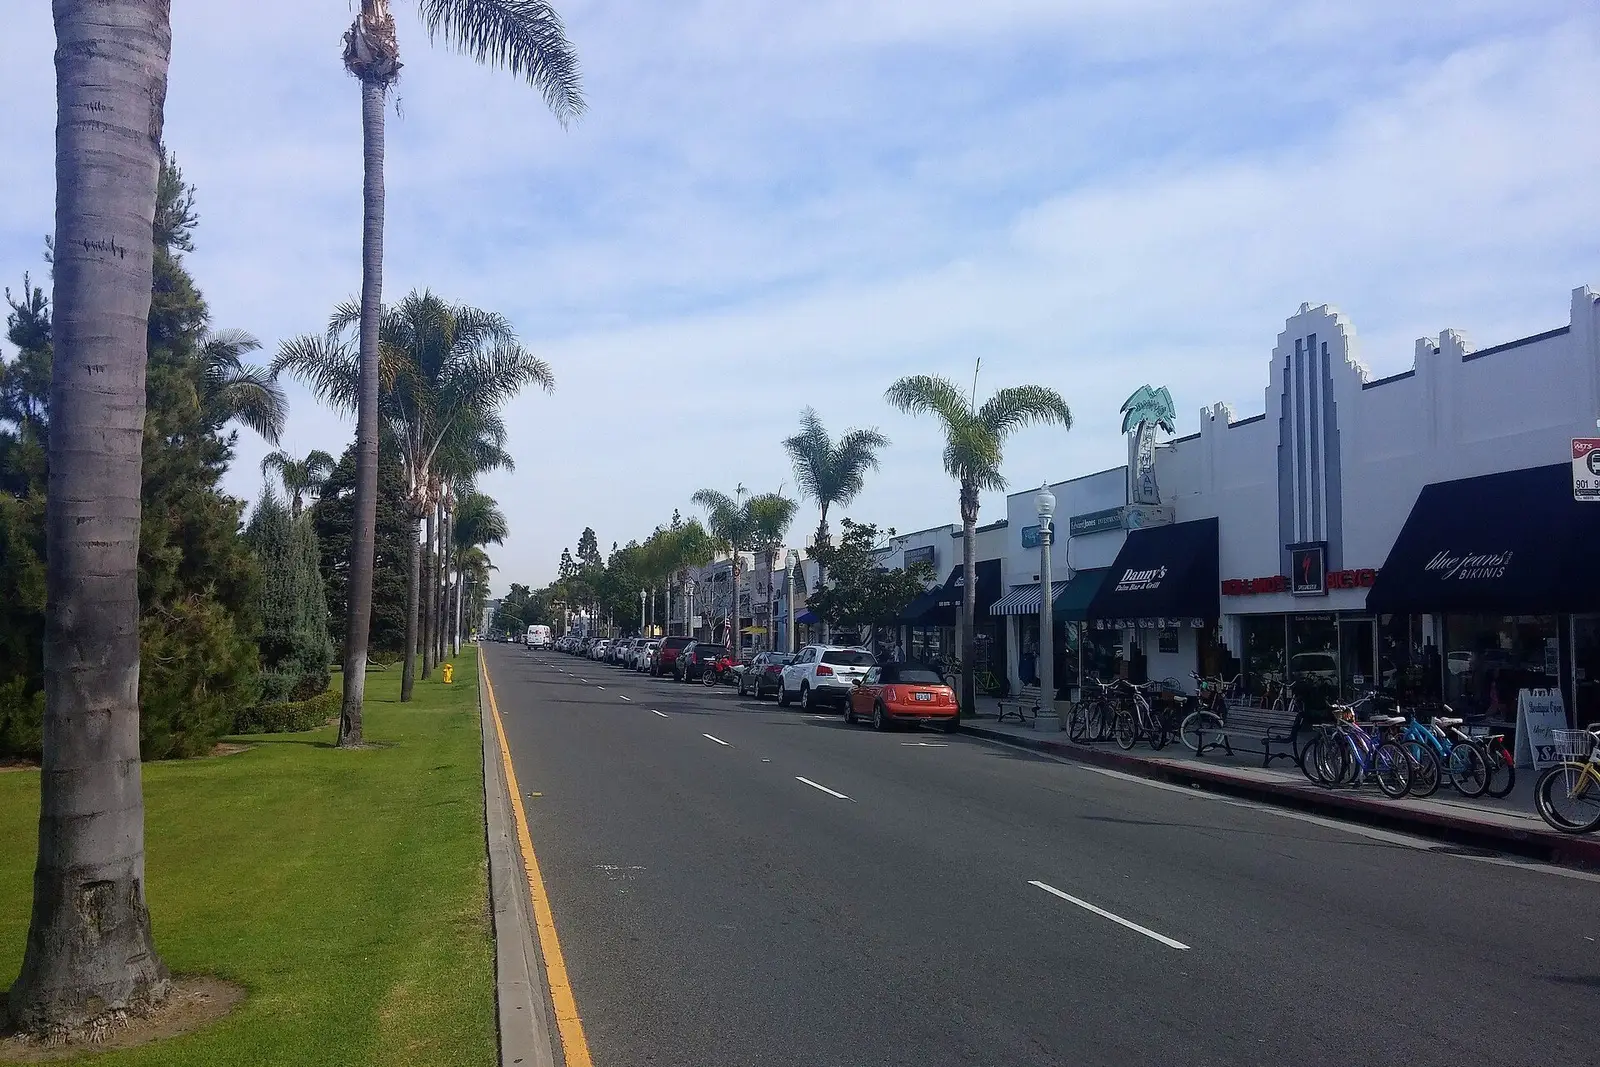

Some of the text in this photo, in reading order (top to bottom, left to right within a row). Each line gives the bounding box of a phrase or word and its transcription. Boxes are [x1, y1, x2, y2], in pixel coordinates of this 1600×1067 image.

[1574, 441, 1592, 451] MTS
[1575, 480, 1600, 488] 901 9
[1424, 550, 1460, 571] blue
[1441, 550, 1508, 580] jeans
[1120, 565, 1168, 583] Danny's
[1459, 566, 1505, 580] BIKINIS
[1146, 581, 1161, 589] Grill
